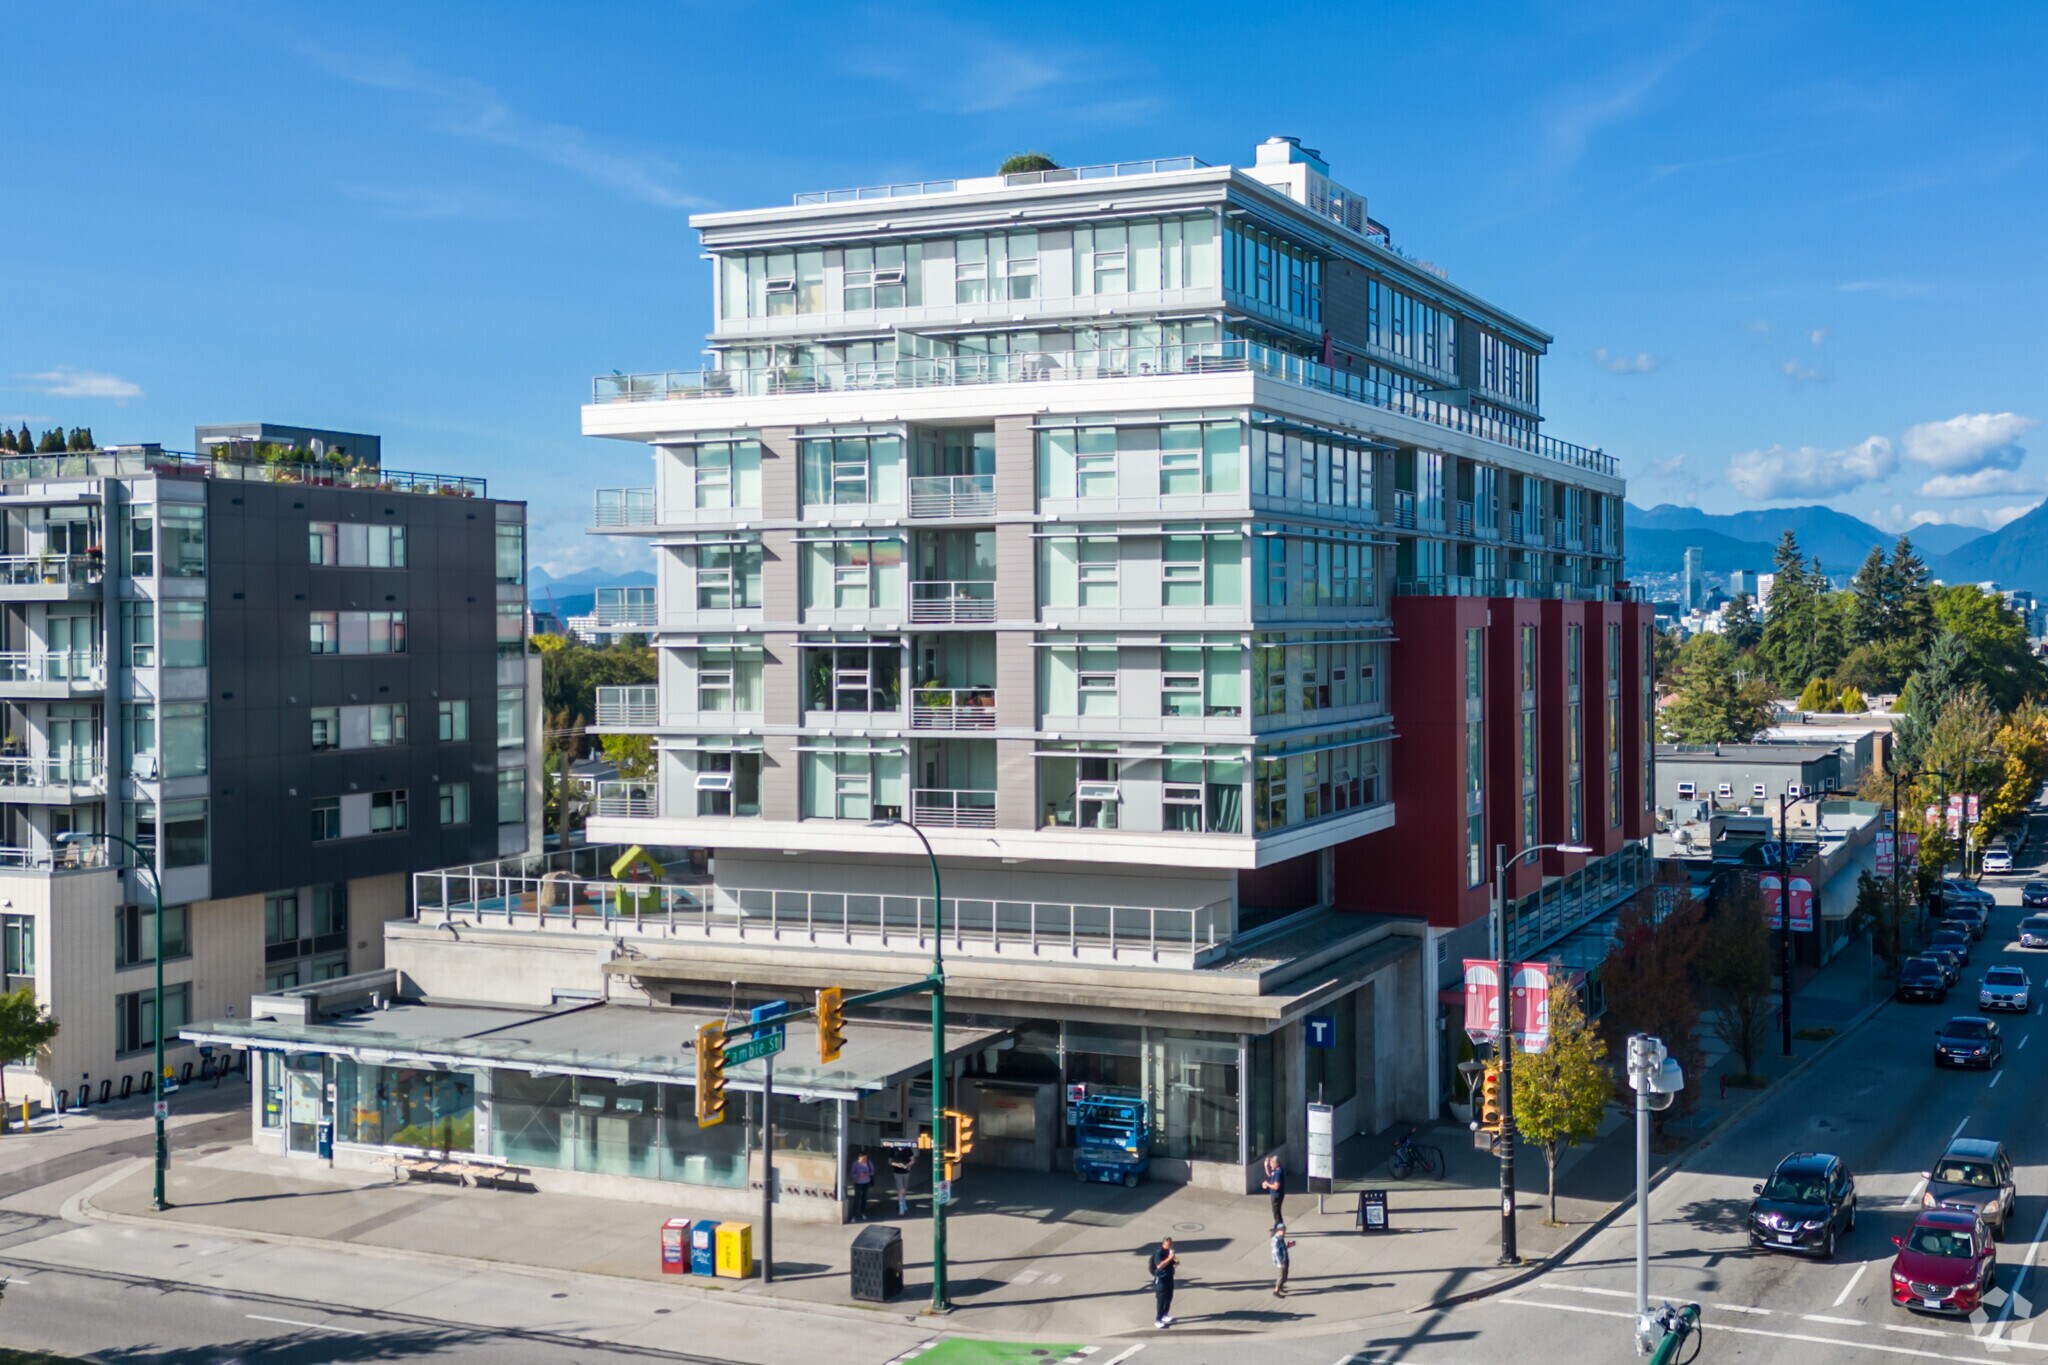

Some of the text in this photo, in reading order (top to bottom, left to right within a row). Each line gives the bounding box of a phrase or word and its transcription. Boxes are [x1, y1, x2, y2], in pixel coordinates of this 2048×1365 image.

[1311, 1022, 1328, 1042] T
[725, 1037, 779, 1065] Cambie St
